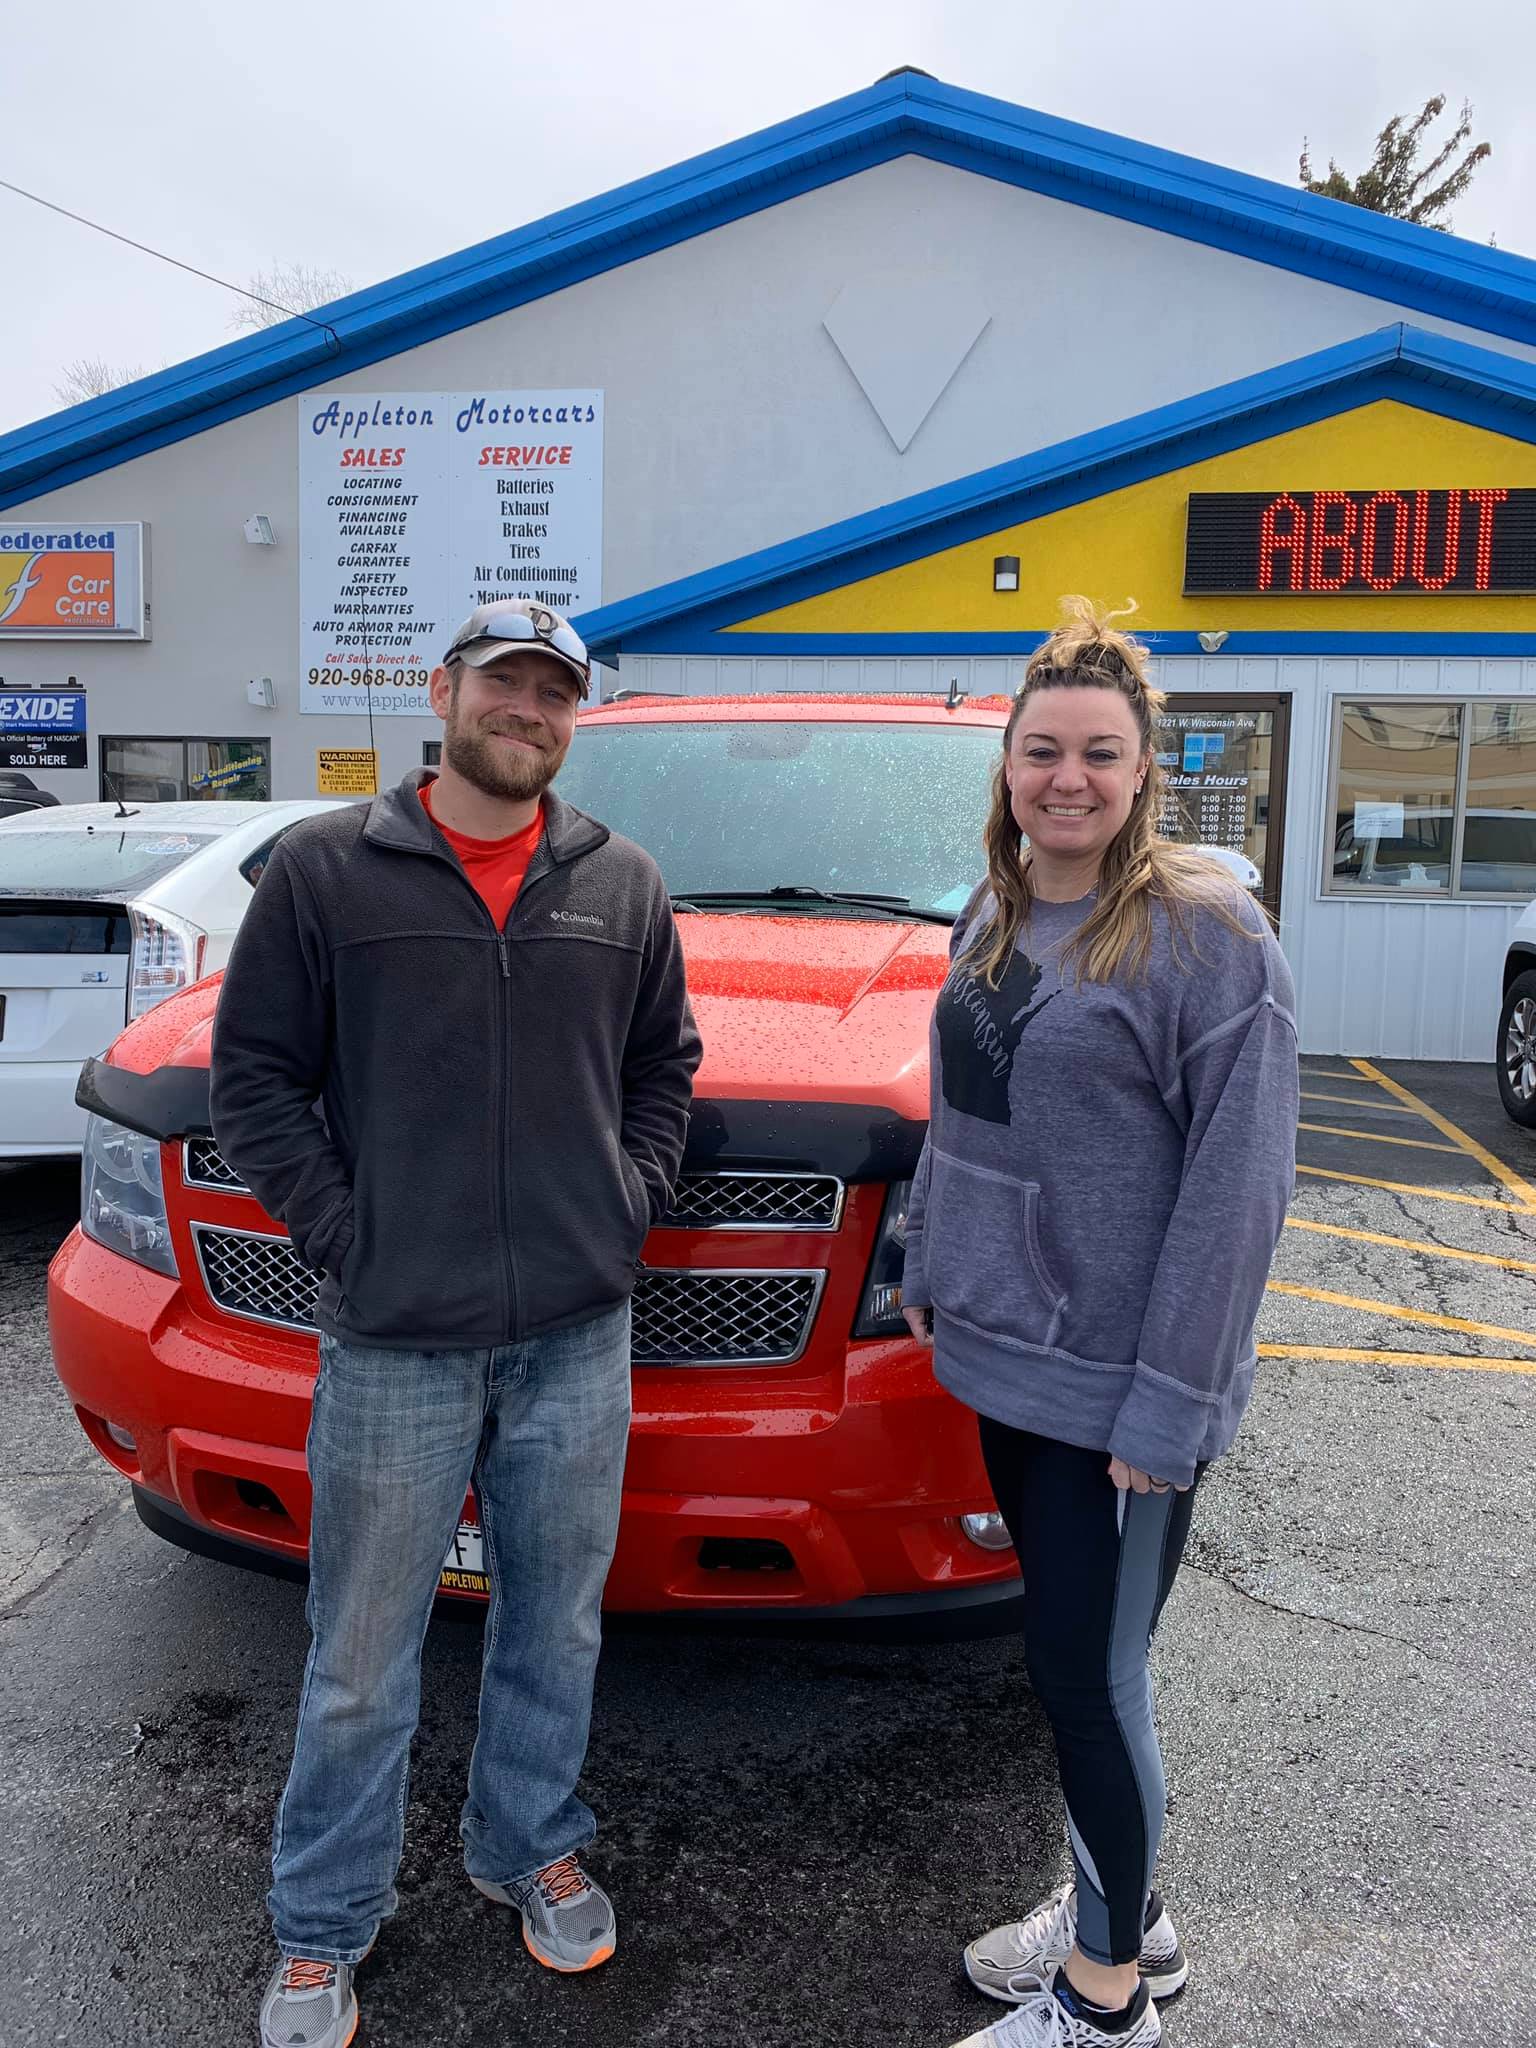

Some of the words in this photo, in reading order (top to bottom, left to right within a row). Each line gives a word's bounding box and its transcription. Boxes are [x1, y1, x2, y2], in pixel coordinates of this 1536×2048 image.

[313, 400, 433, 438] Appleton
[456, 398, 594, 432] Motorcars
[340, 448, 406, 467] SALES
[478, 446, 573, 466] SERVICE
[344, 478, 402, 489] LOCATING
[496, 479, 554, 495] Batteries
[327, 495, 418, 506] CONSIGNMENT
[500, 500, 550, 516] Exhaust
[338, 512, 408, 524] FINANCING
[340, 525, 406, 536] AVAILABLE
[502, 522, 548, 538] Brakes
[0, 531, 115, 550] ederated
[1257, 488, 1508, 591] ABOUT
[350, 543, 397, 554] CARFAX
[510, 544, 540, 560] Tires
[337, 556, 410, 567] GUARANTEE
[352, 573, 396, 584] SAFETY
[474, 566, 492, 582] Air
[496, 566, 578, 584] Conditioning
[67, 574, 111, 594] Car
[340, 586, 408, 596] INSPECTED
[535, 590, 572, 606] Minor
[55, 596, 111, 616] Care
[333, 604, 414, 615] WARRANTIES
[312, 622, 344, 632] AUTO
[348, 622, 394, 633] ARMOR
[398, 622, 436, 634] PAINT
[335, 635, 412, 646] PROTECTION
[325, 653, 344, 664] Call
[346, 654, 373, 664] Sales
[376, 654, 406, 664] Direct
[408, 654, 424, 664] At:
[308, 668, 429, 687] 920-968-039
[0, 698, 76, 720] EXIDE
[1158, 718, 1176, 728] 1221
[1178, 718, 1188, 728] W.
[1190, 718, 1235, 728] Wisconsin
[1237, 719, 1256, 728] Ave.
[26, 735, 46, 744] Battery
[10, 754, 37, 766] SOLD
[40, 754, 68, 766] HERE
[192, 773, 205, 784] Air
[208, 756, 262, 779] Conditioning
[212, 773, 240, 788] Repair
[1162, 774, 1200, 786] Sales
[1204, 774, 1248, 786] Hours
[1202, 795, 1220, 803] 9:00
[1228, 795, 1246, 803] 7:00
[1228, 805, 1246, 813] 7:00
[1201, 814, 1219, 822] 9:00
[1228, 814, 1246, 822] 7:00
[1158, 824, 1183, 832] Thurs
[1200, 824, 1218, 832] 9:00
[1228, 824, 1245, 832] 7:00
[1226, 834, 1246, 842] 6:00
[560, 911, 604, 926] Columbia
[442, 1572, 484, 1590] APPLETON
